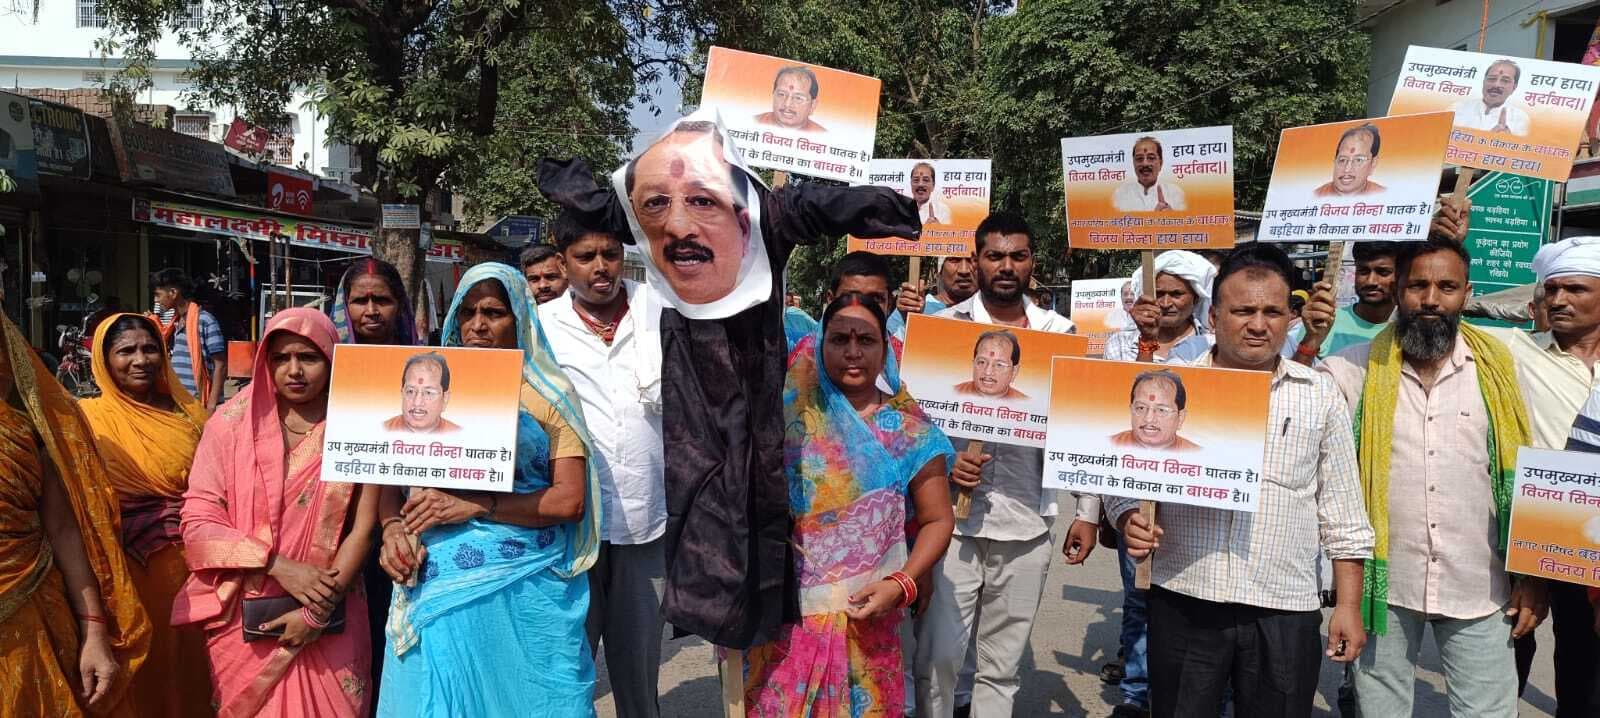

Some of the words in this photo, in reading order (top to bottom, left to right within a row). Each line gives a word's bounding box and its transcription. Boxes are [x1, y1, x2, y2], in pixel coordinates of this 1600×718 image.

[1408, 61, 1478, 79] उपमुख्यमंत्री
[1402, 77, 1436, 91] विजय
[1438, 80, 1473, 96] सिन्हा
[1531, 73, 1557, 87] हाय
[1560, 77, 1593, 92] हाय।
[762, 132, 793, 148] विजय
[797, 138, 827, 154] सिन्हा
[829, 146, 858, 159] घातक
[1172, 144, 1194, 157] हाय
[1199, 142, 1227, 155] हाय।
[748, 149, 759, 159] के
[762, 151, 794, 166] विकास
[797, 158, 811, 169] का
[813, 160, 847, 174] बाधक
[1067, 150, 1125, 167] उपमुख्यमंत्री
[1482, 153, 1506, 165] हाय
[944, 171, 961, 182] हाय
[1068, 170, 1095, 183] विजय
[1099, 168, 1126, 181] सिन्हा
[1266, 210, 1277, 219] उप
[1279, 206, 1318, 221] मुख्यमंत्री
[1320, 203, 1350, 217] विजय
[1352, 202, 1384, 216] सिन्हा
[1386, 204, 1416, 215] घातक
[296, 222, 369, 248] मिष्टा
[1089, 232, 1118, 244] विजय
[1123, 231, 1152, 244] सिन्हा
[1157, 233, 1177, 244] हाय
[1269, 223, 1305, 239] बड़हिया
[1306, 224, 1316, 235] के
[1319, 223, 1349, 236] विकास
[1352, 225, 1366, 235] का
[1368, 223, 1404, 235] बाधक
[961, 401, 994, 418] विजय
[996, 407, 1028, 422] सिन्हा
[1030, 414, 1048, 425] घात
[948, 419, 960, 430] के
[962, 420, 994, 436] विकास
[997, 426, 1012, 437] का
[1013, 428, 1047, 441] बाधक
[327, 441, 341, 452] उप
[344, 441, 389, 456] मुख्यमंत्री
[392, 440, 425, 457] विजय
[429, 441, 463, 459] सिन्हा
[465, 447, 498, 461] घातक
[334, 459, 376, 477] बड़हिया
[378, 464, 390, 475] के
[392, 463, 428, 478] विकास
[431, 468, 446, 479] का
[448, 467, 488, 481] बाधक
[1048, 451, 1064, 462] उप
[1067, 452, 1118, 469] मुख्यमंत्री
[1121, 454, 1161, 474] विजय
[1163, 458, 1202, 477] सिन्हा
[1205, 468, 1242, 482] घातक
[1057, 470, 1105, 488] बड़हिया
[1106, 474, 1119, 488] के
[1123, 476, 1162, 493] विकास
[1165, 484, 1184, 496] का
[1186, 484, 1230, 501] बाधक
[1523, 467, 1600, 486] उपमुख्यमं
[1521, 483, 1563, 502] विजय
[1512, 539, 1538, 550] नगर
[1541, 543, 1574, 557] परिषद
[1578, 548, 1600, 563] बड़
[1539, 557, 1586, 578] विजय
